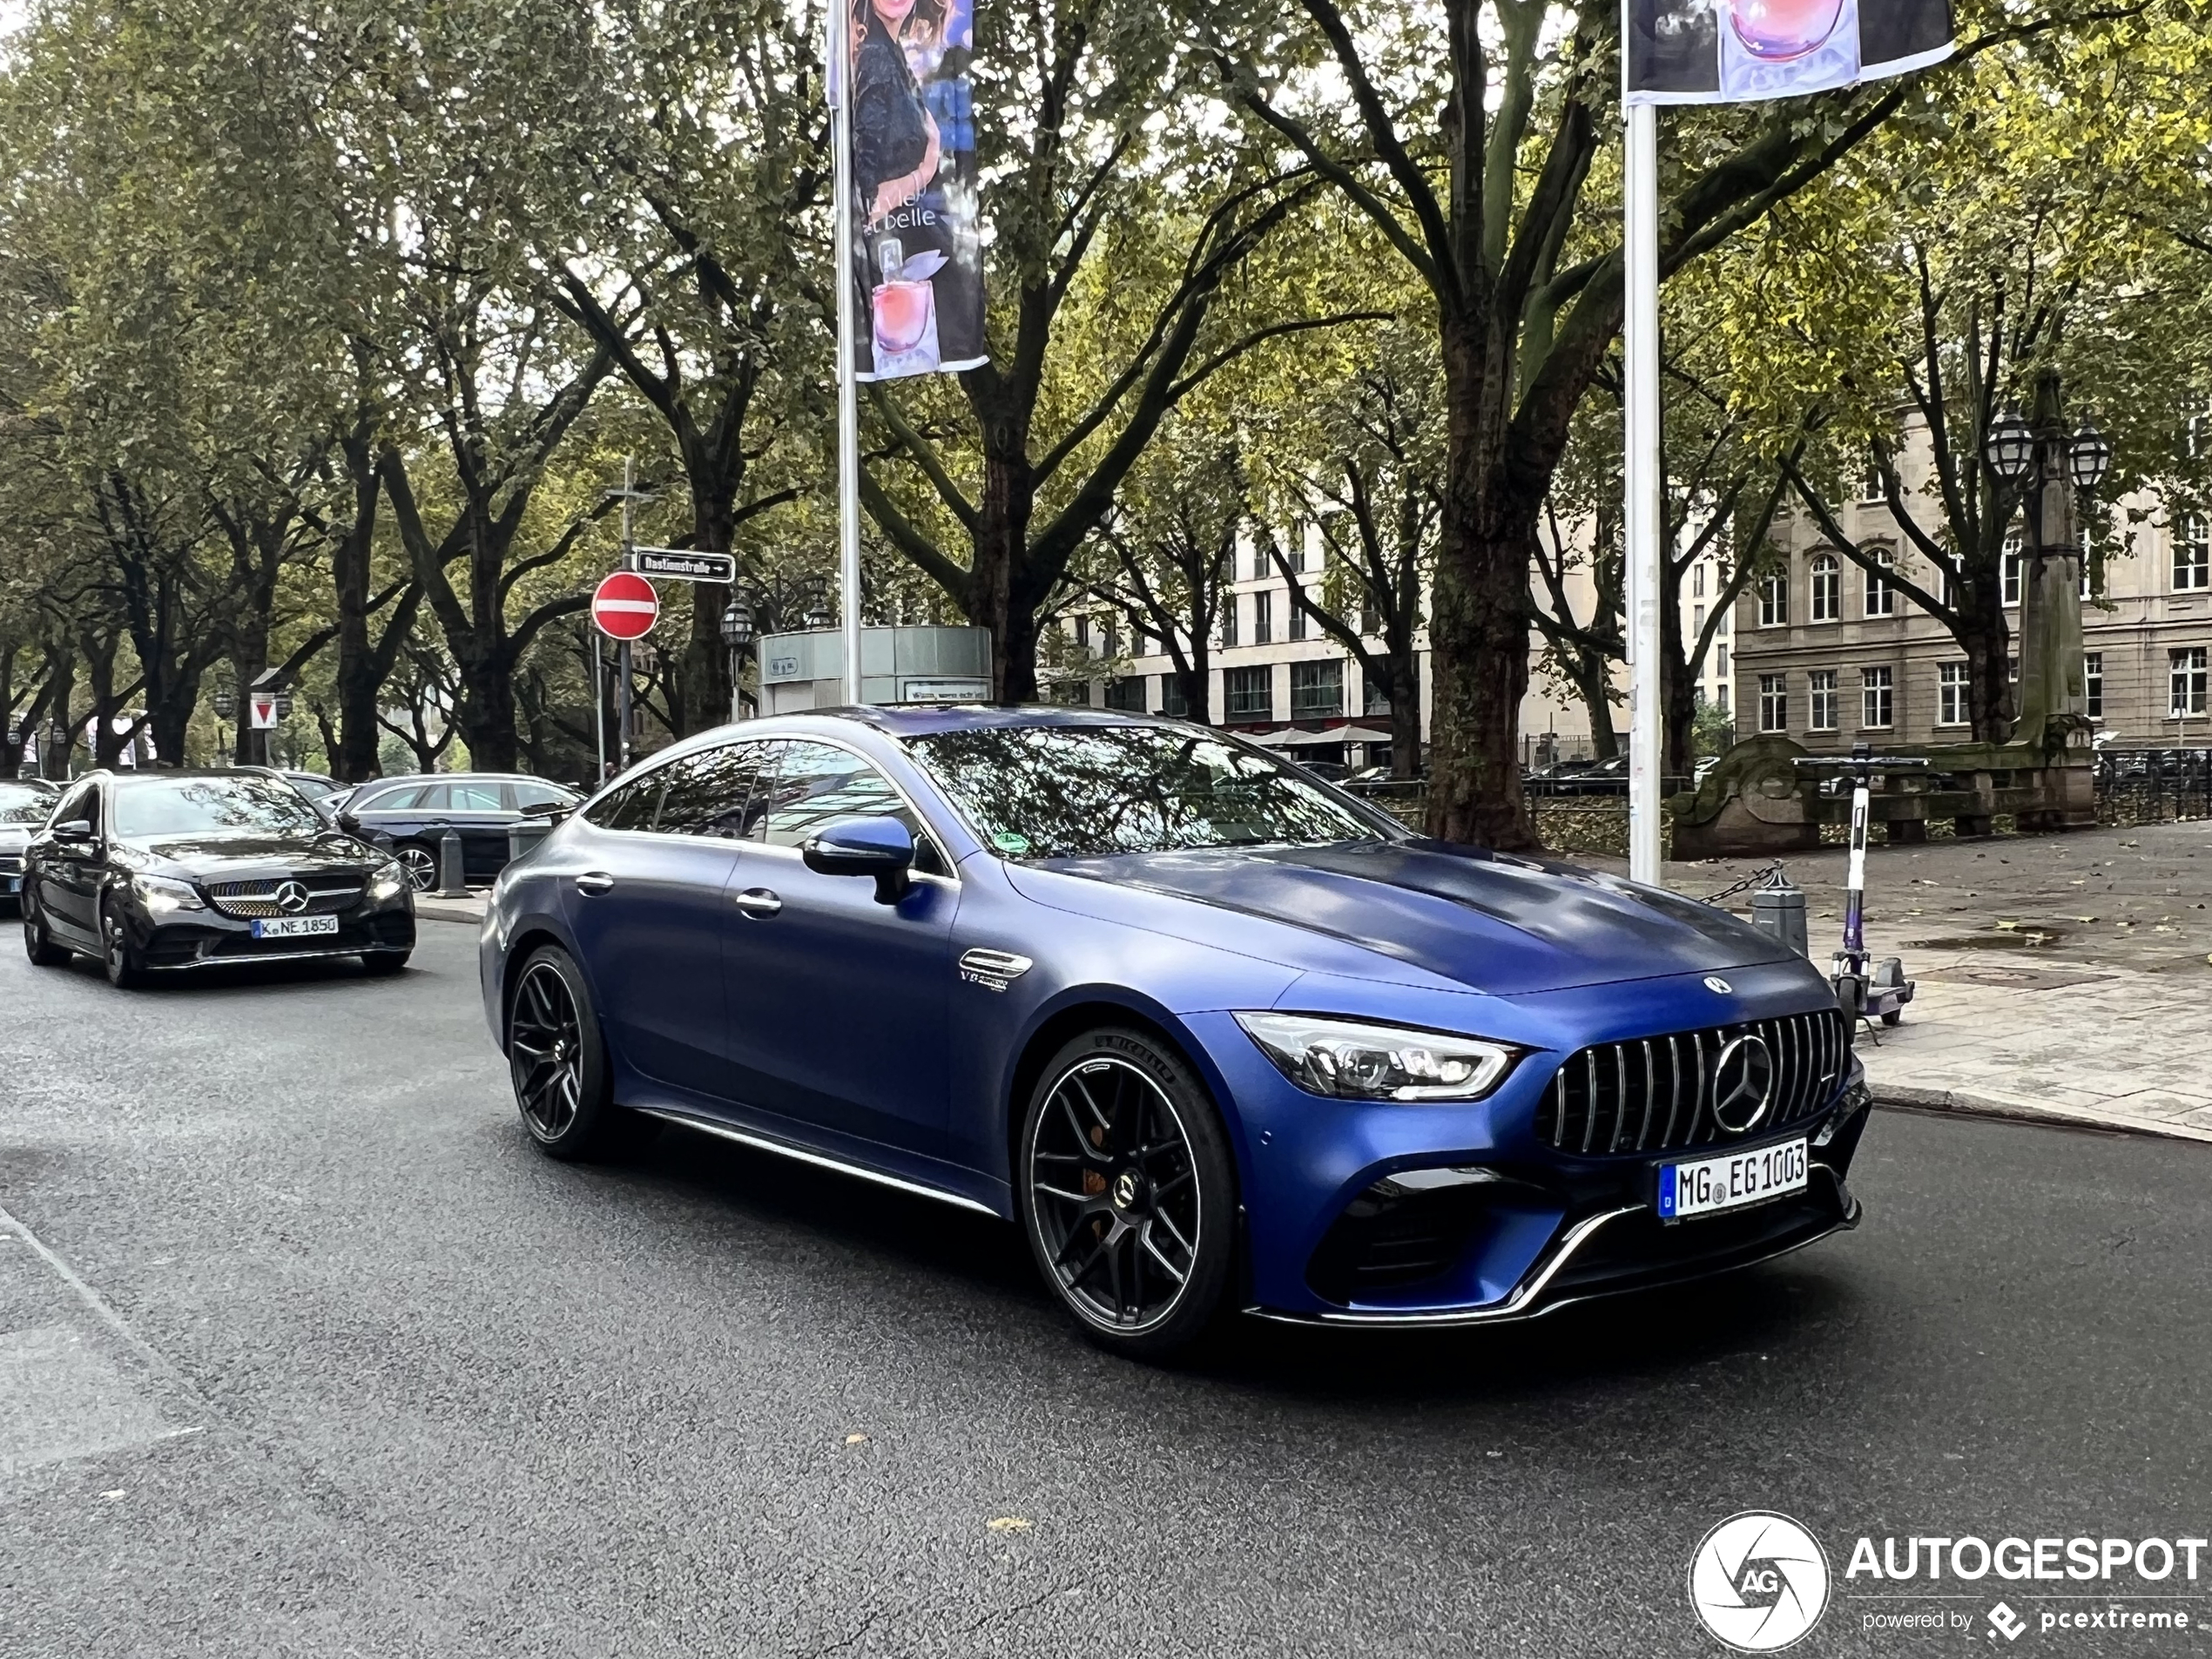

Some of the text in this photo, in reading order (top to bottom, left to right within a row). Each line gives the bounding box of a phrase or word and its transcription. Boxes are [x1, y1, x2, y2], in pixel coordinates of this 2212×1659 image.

[884, 207, 936, 231] belle
[261, 918, 335, 935] K NE 1850
[1679, 1143, 1804, 1208] MG EG 1003
